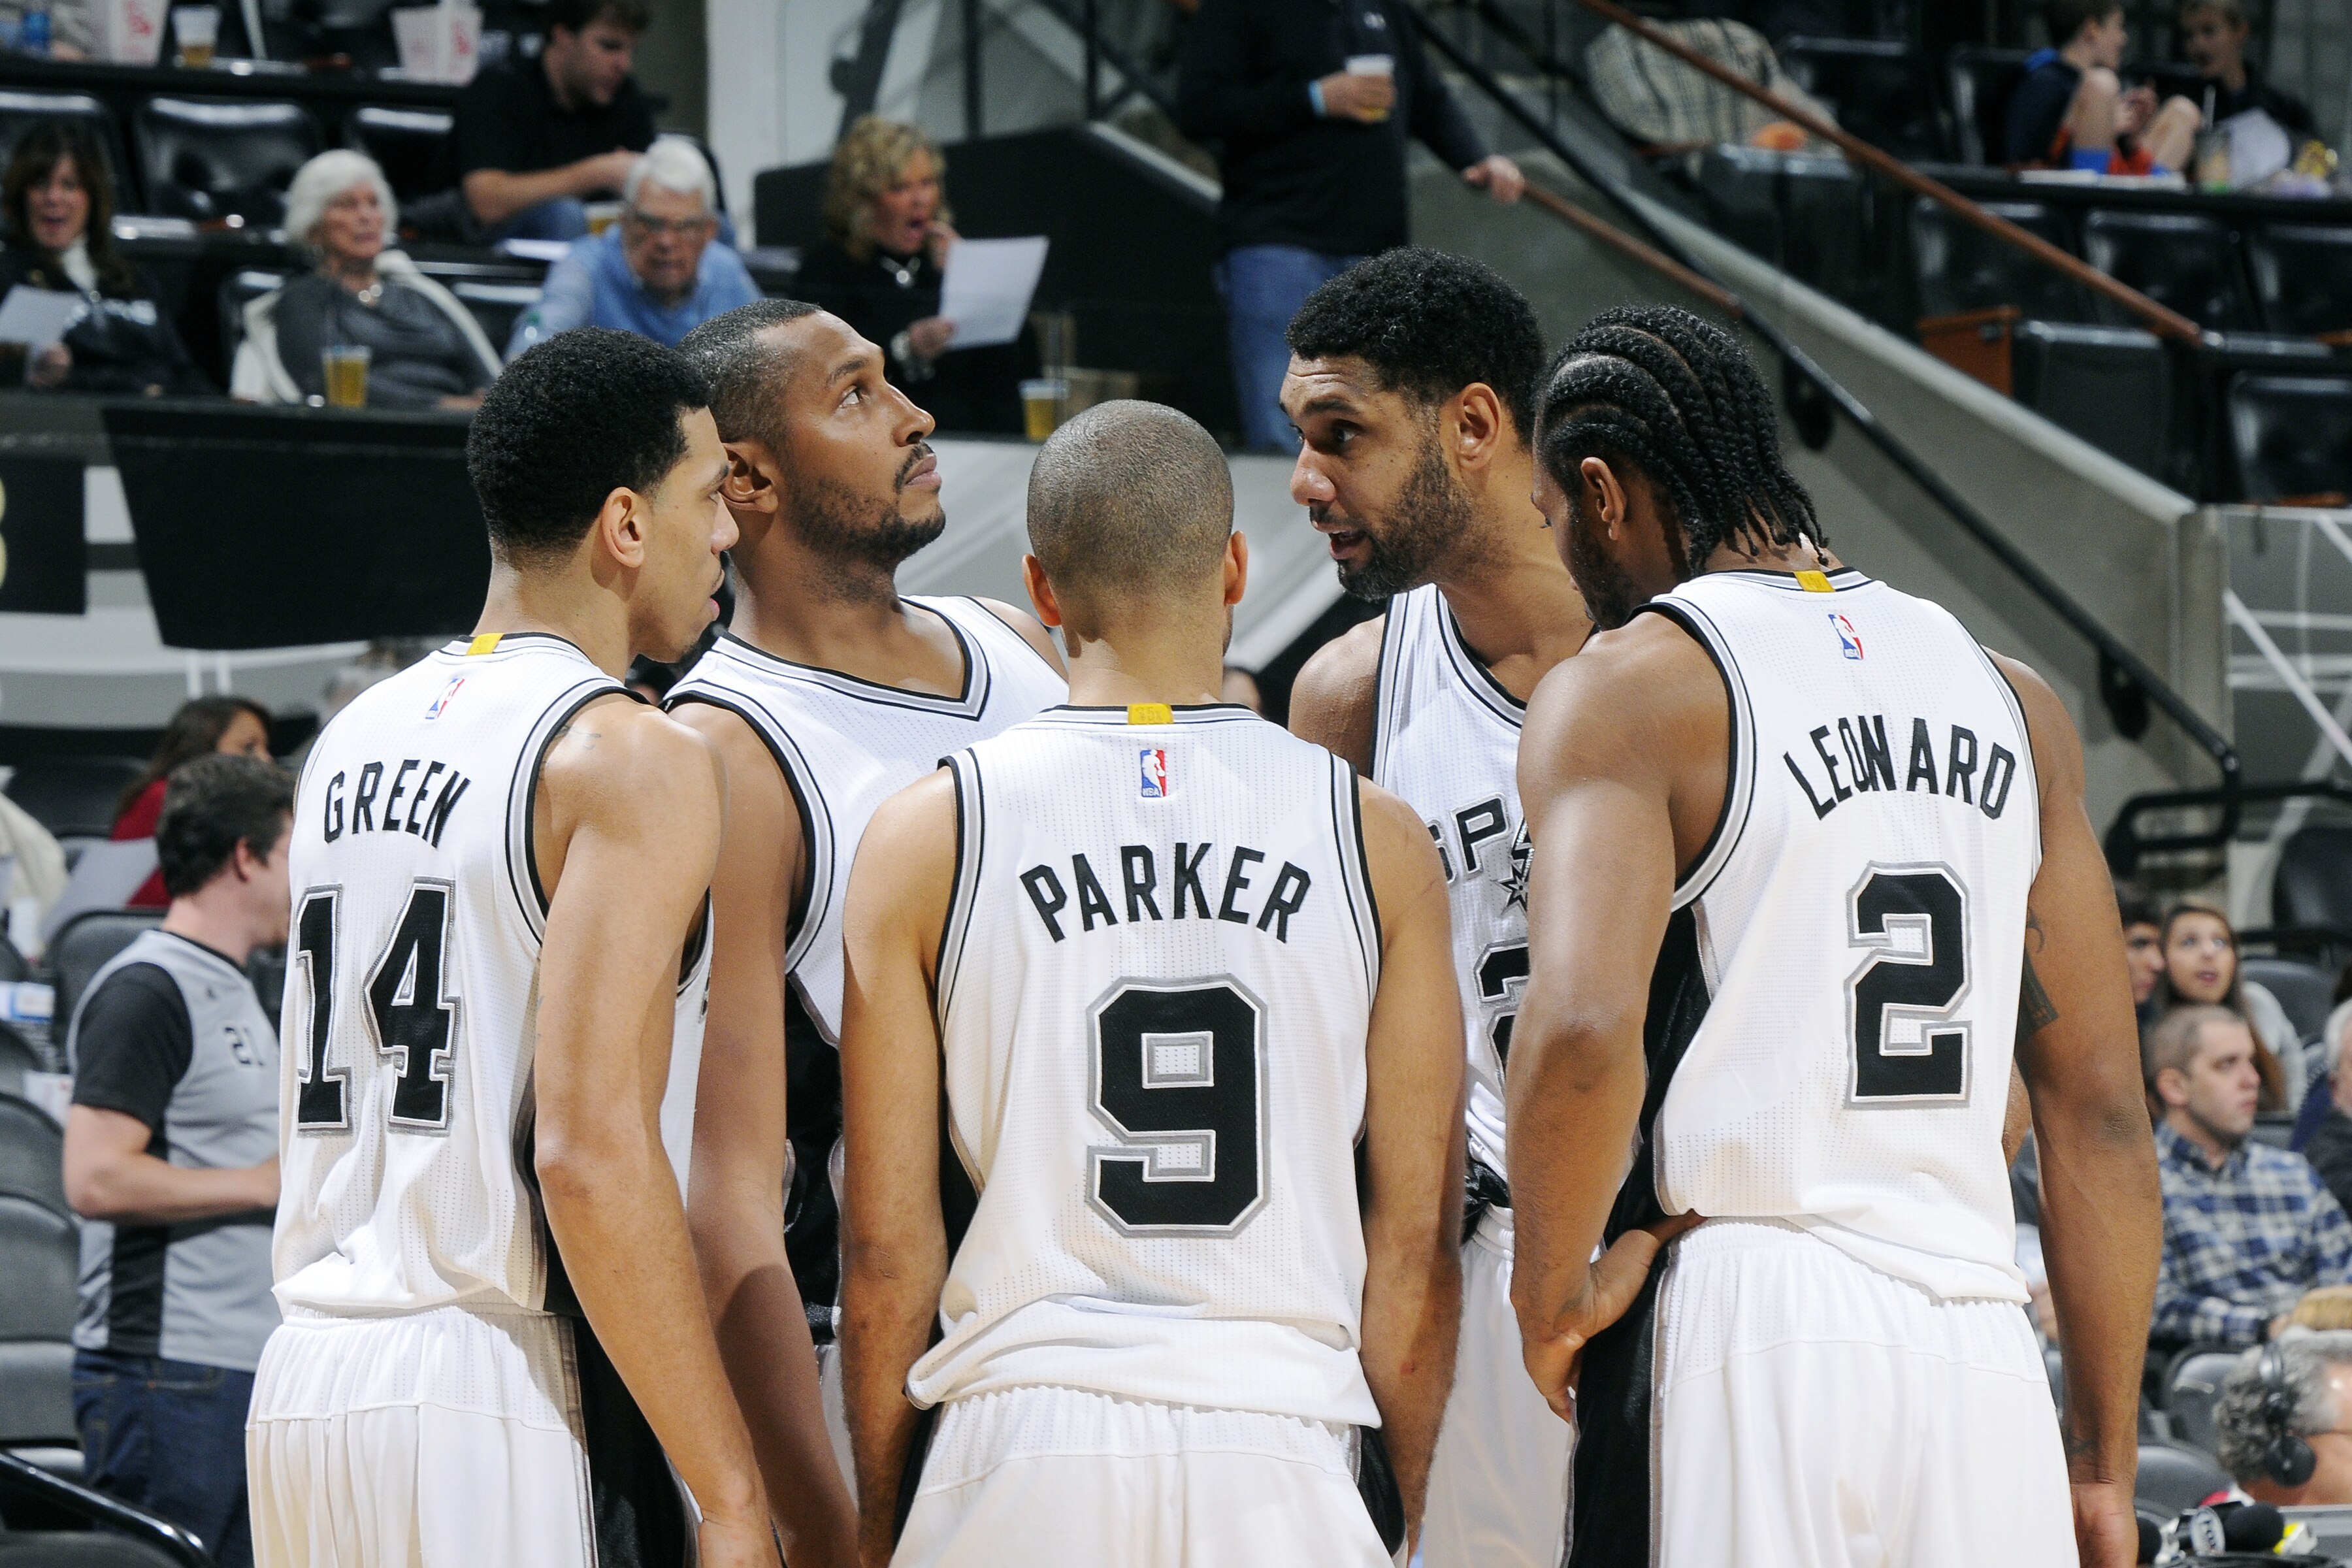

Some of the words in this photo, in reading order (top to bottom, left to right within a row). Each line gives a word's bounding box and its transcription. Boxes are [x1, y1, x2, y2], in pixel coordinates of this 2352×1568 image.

[324, 759, 471, 849] GREEN
[1784, 715, 2016, 822] LEONARD
[1019, 842, 1311, 945] PARKER
[296, 875, 461, 1136] 14
[1843, 860, 1972, 1109] 2
[1086, 972, 1271, 1238] 9
